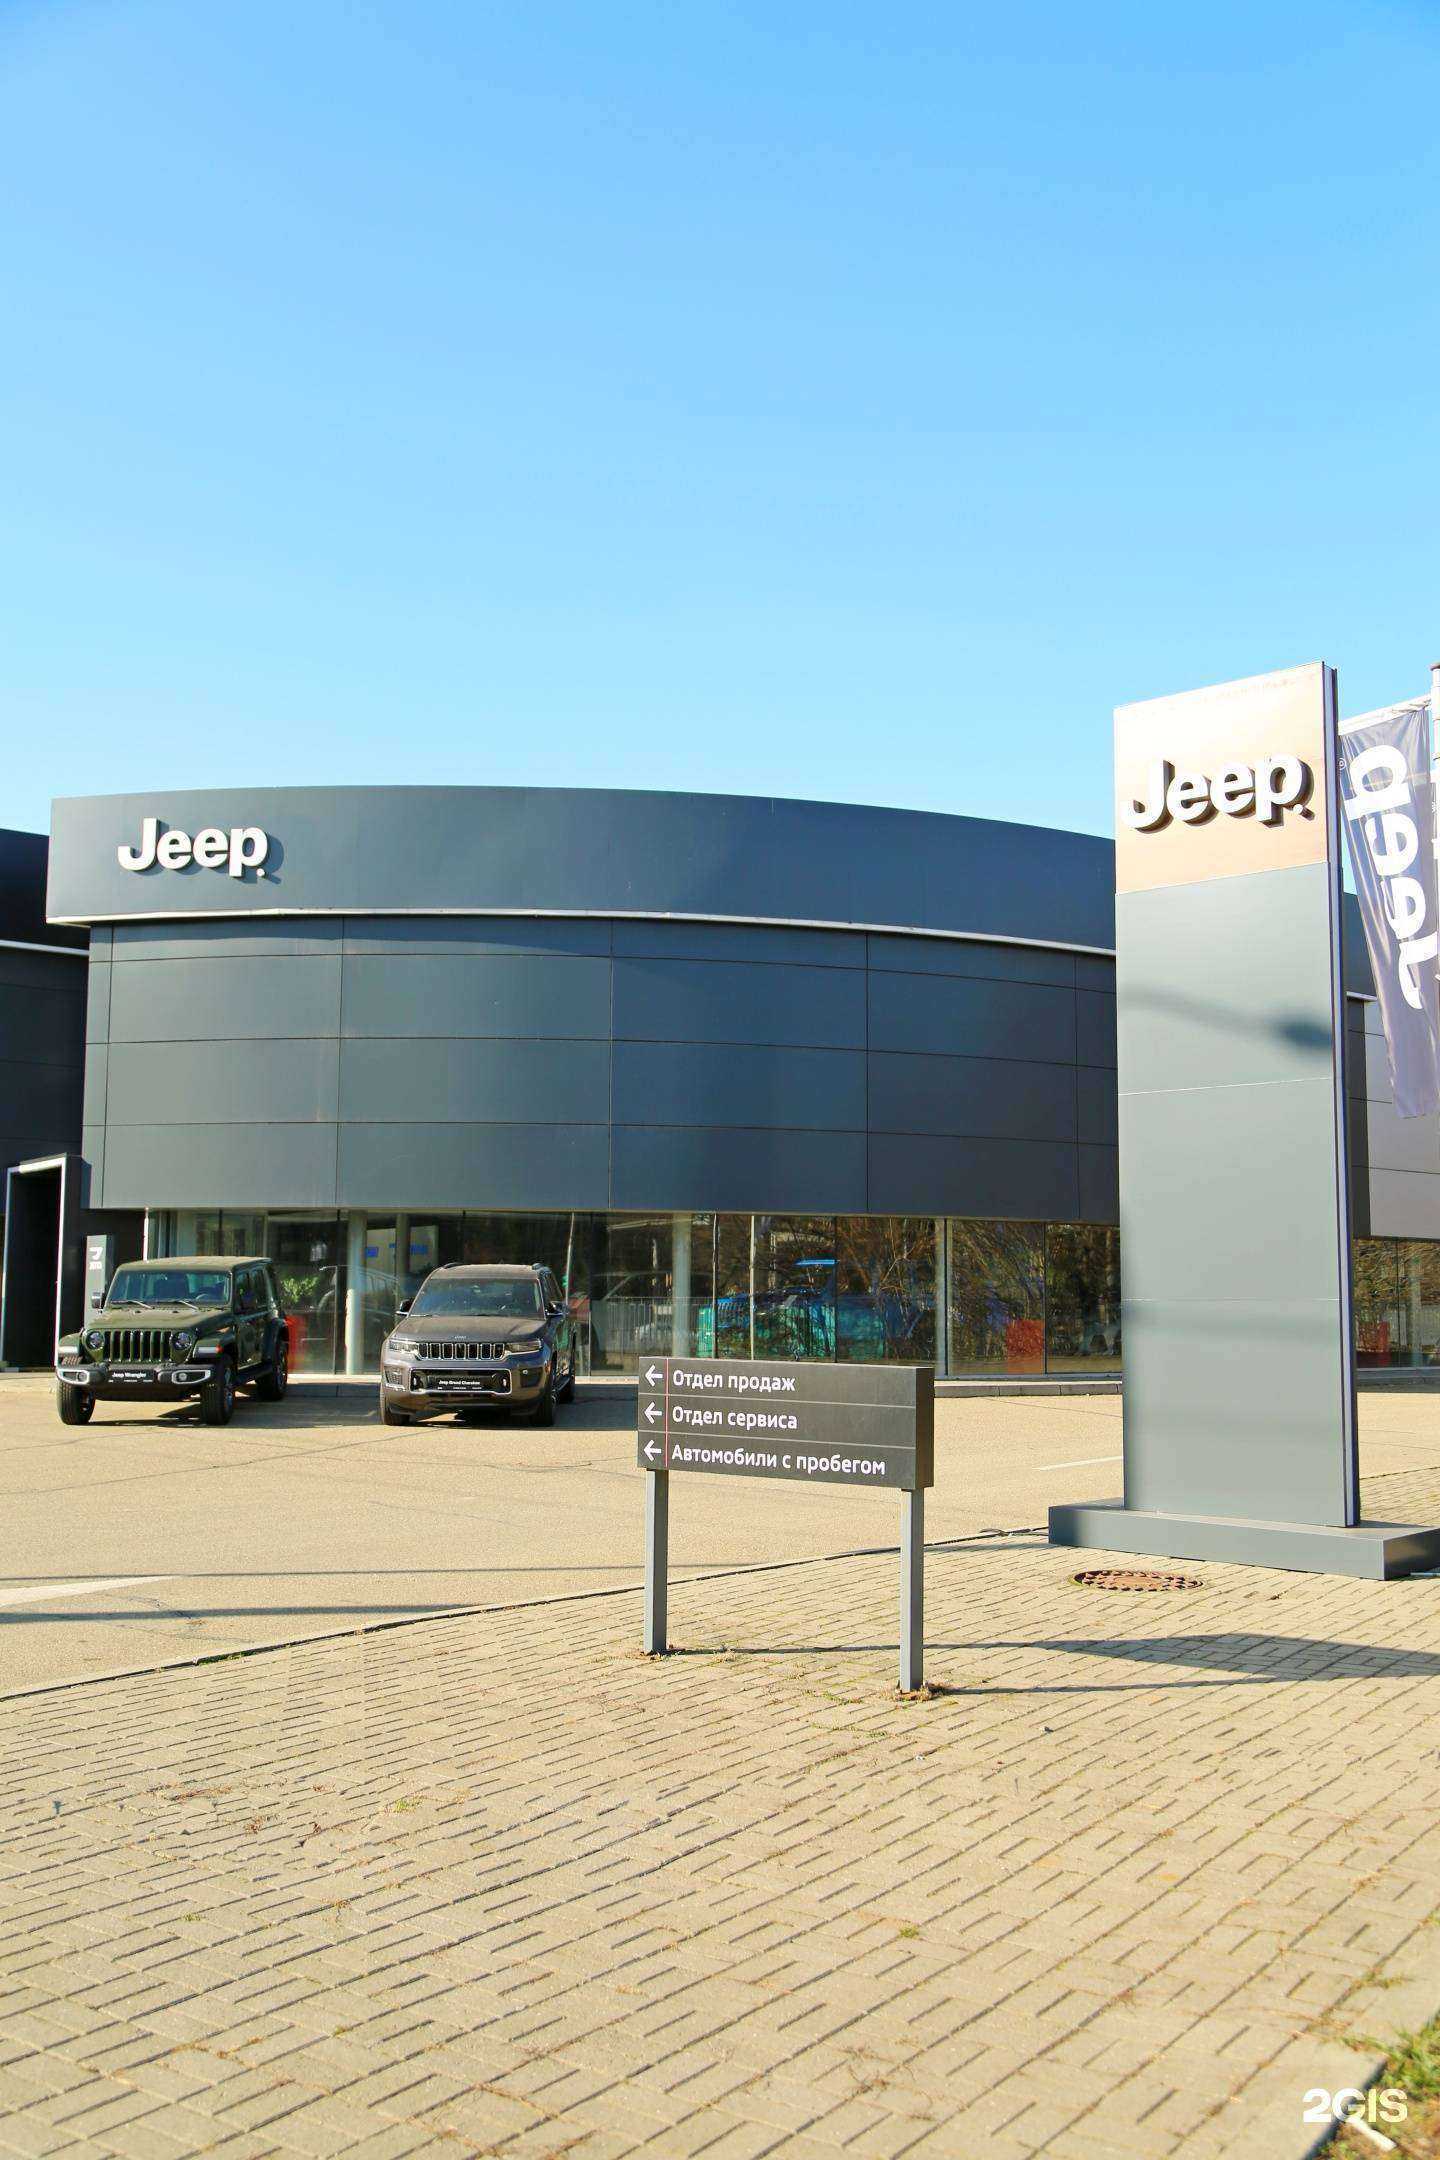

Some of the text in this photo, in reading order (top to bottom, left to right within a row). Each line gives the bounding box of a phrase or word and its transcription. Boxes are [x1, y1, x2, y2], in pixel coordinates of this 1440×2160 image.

[673, 1369, 796, 1392] Отдел продаж
[672, 1406, 798, 1430] Отдел сервиса
[671, 1444, 886, 1475] Автомобили с пробегом
